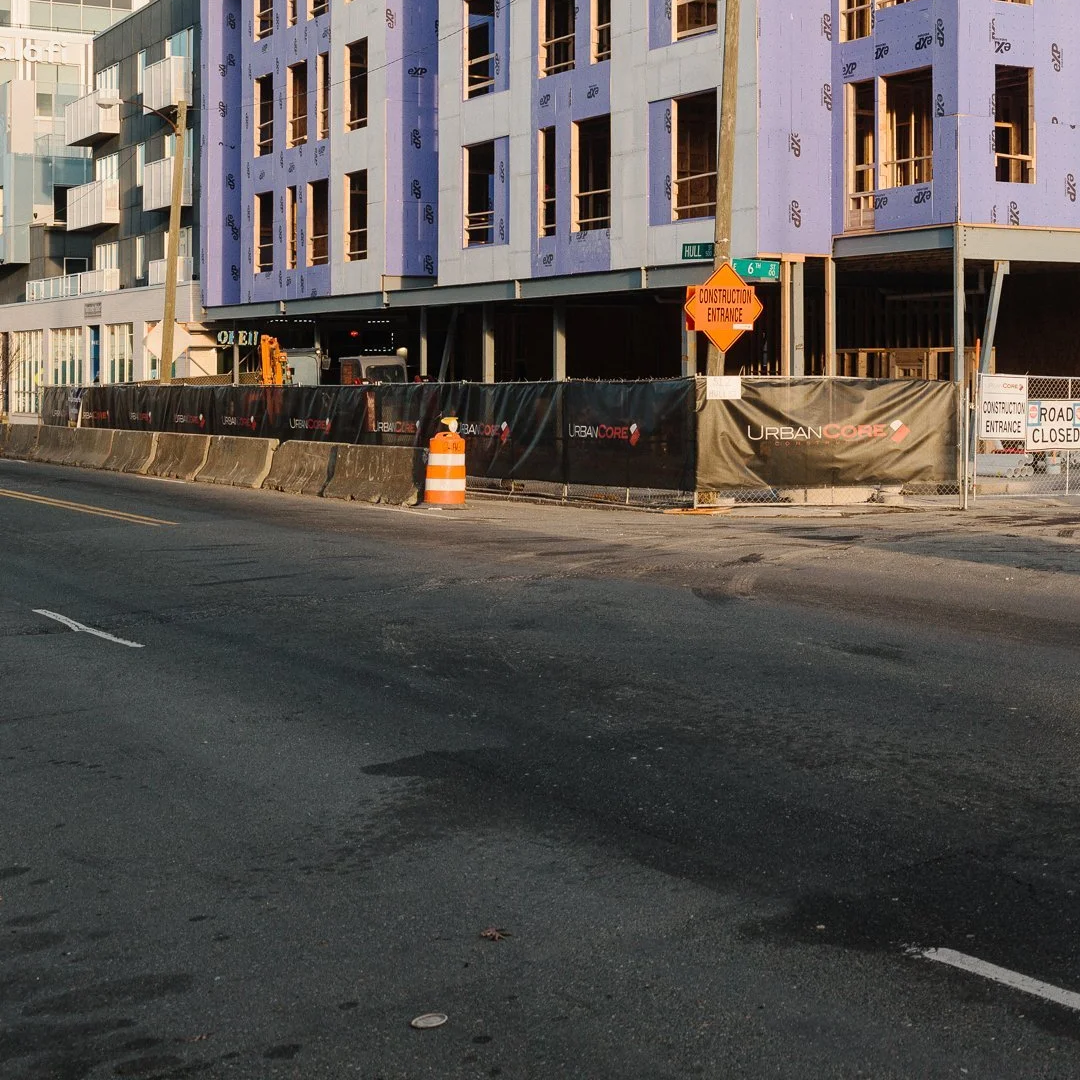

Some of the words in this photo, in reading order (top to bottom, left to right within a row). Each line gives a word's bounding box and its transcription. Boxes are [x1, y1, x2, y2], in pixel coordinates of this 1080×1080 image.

[386, 8, 394, 29] eXP
[824, 14, 832, 42] eXP
[915, 35, 932, 50] eXP
[1051, 43, 1060, 72] eXP
[408, 67, 427, 75] eXP
[587, 86, 599, 98] eXP
[824, 83, 832, 111] eXP
[540, 94, 550, 106] eXP
[413, 129, 421, 149] eXP
[413, 180, 421, 199] eXP
[1067, 173, 1076, 202] eXP
[914, 190, 931, 204] eXP
[791, 200, 801, 228] eXP
[684, 245, 702, 257] HULL
[543, 255, 553, 265] eXP
[700, 289, 752, 304] CONSTRUCTION
[707, 308, 743, 322] ENTRANCE
[983, 401, 1025, 414] CONSTRUCTION
[1040, 407, 1073, 422] ROAD
[568, 424, 629, 439] URBANCORE
[748, 424, 887, 440] URBANCORE
[986, 421, 1021, 433] ENTRANCE
[1032, 428, 1080, 443] CLOSED
